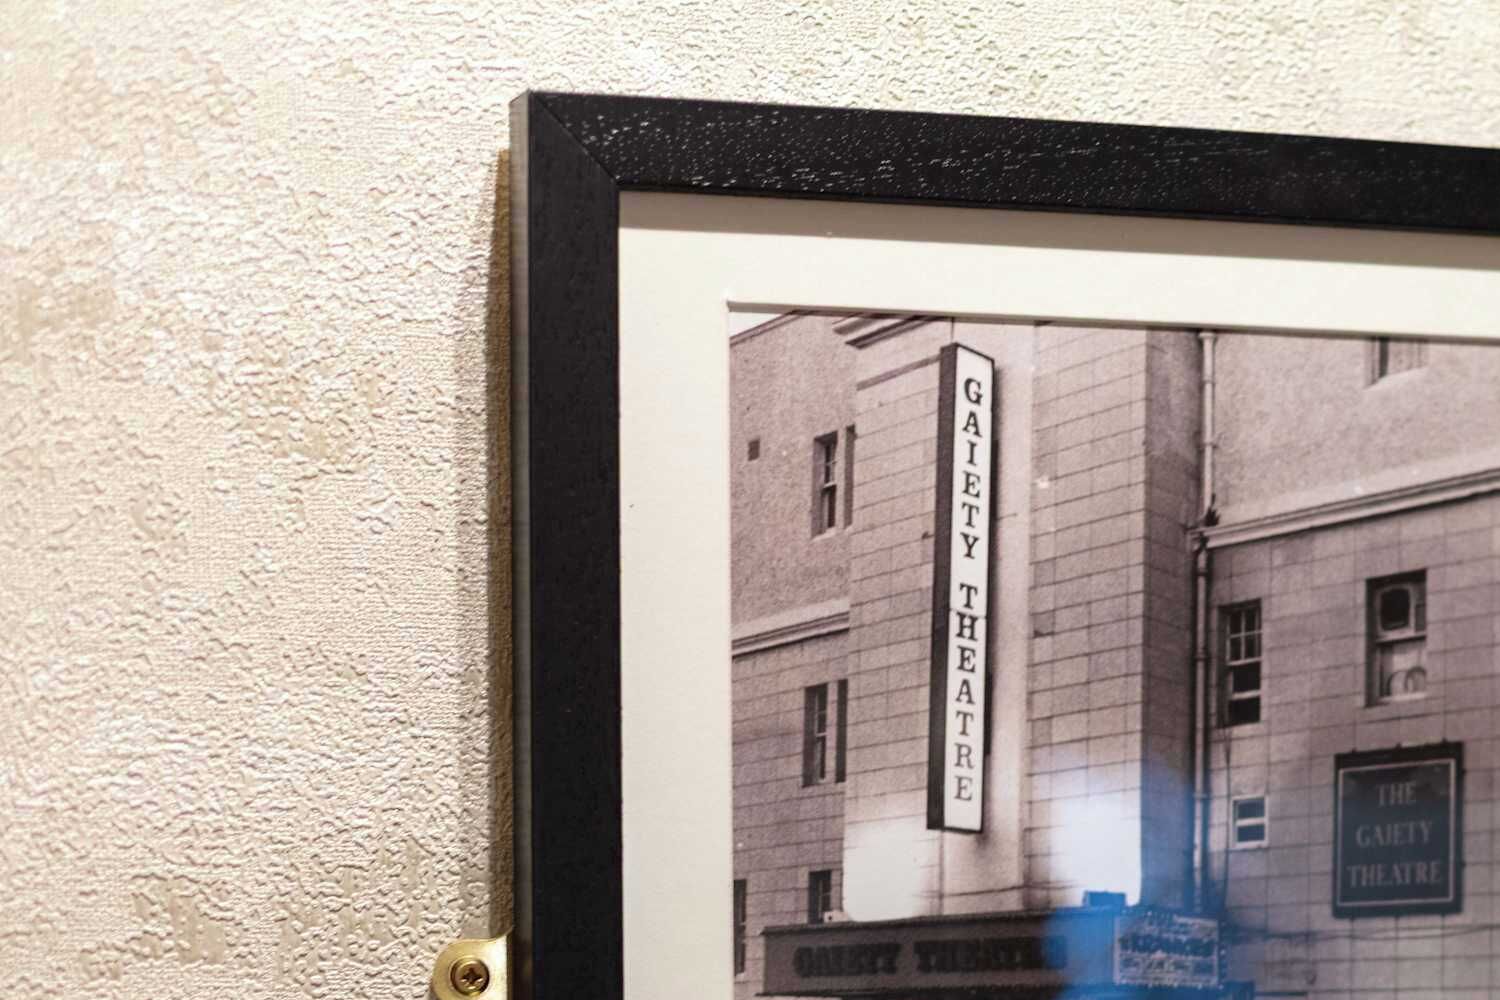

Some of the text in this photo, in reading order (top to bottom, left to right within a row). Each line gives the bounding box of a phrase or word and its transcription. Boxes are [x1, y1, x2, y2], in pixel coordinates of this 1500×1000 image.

[953, 376, 983, 801] GAIETY THEATRE
[1376, 782, 1417, 806] THE
[1355, 820, 1433, 848] GAIETY
[1346, 860, 1442, 888] THEATRE
